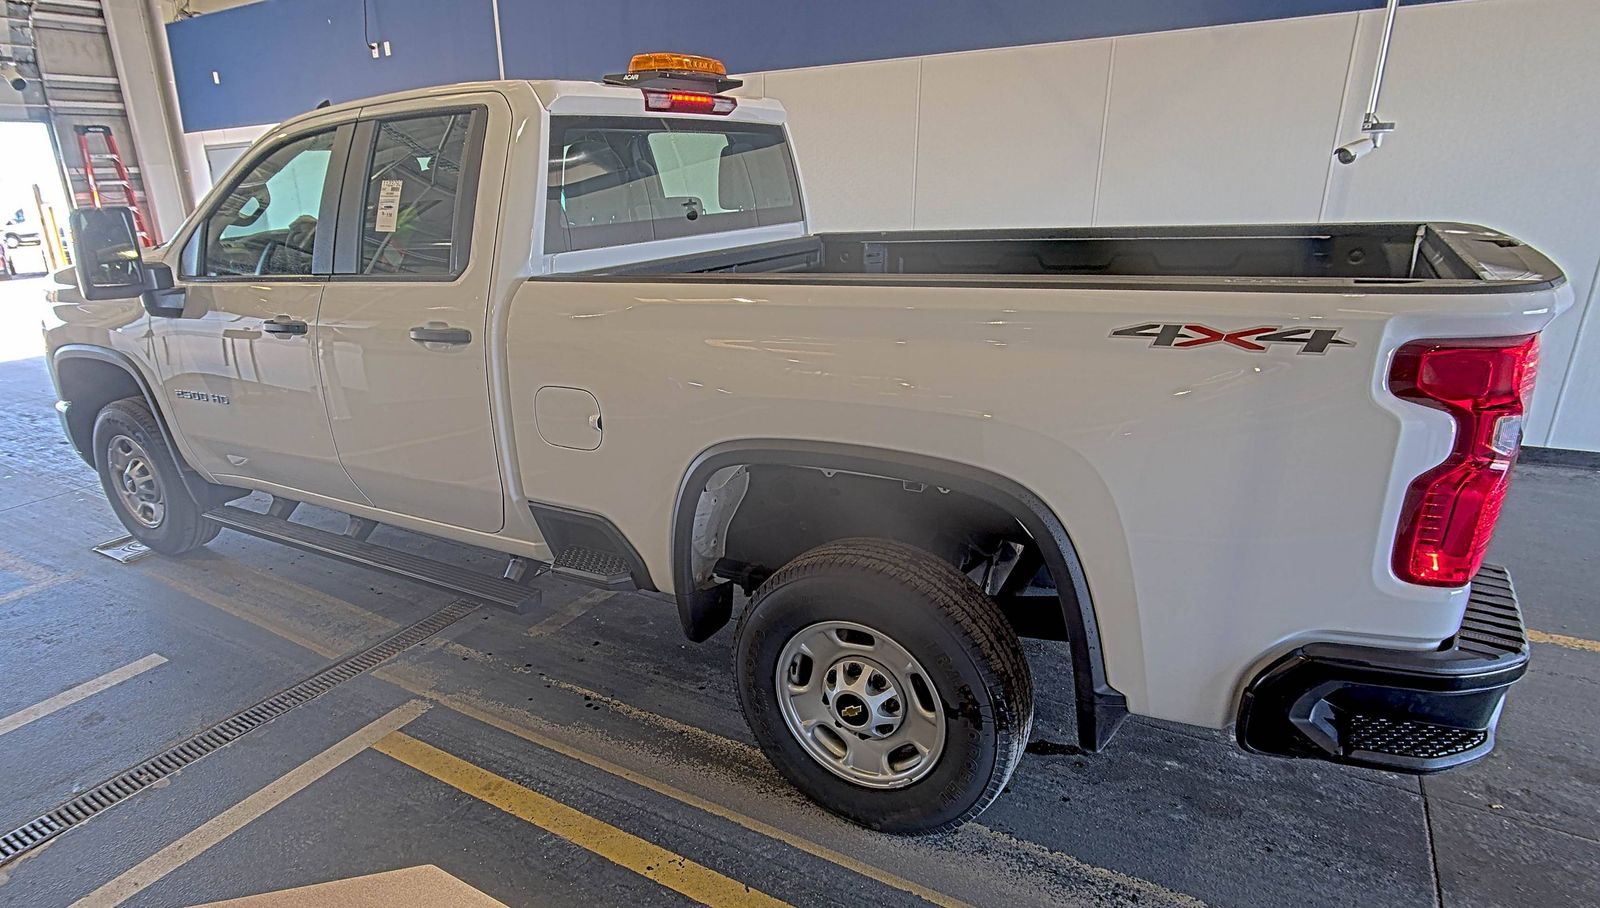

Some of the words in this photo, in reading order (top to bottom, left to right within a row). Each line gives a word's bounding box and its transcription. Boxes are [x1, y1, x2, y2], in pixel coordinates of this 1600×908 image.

[1109, 322, 1356, 355] 4X4
[174, 389, 209, 402] 2500
[210, 393, 230, 405] HD
